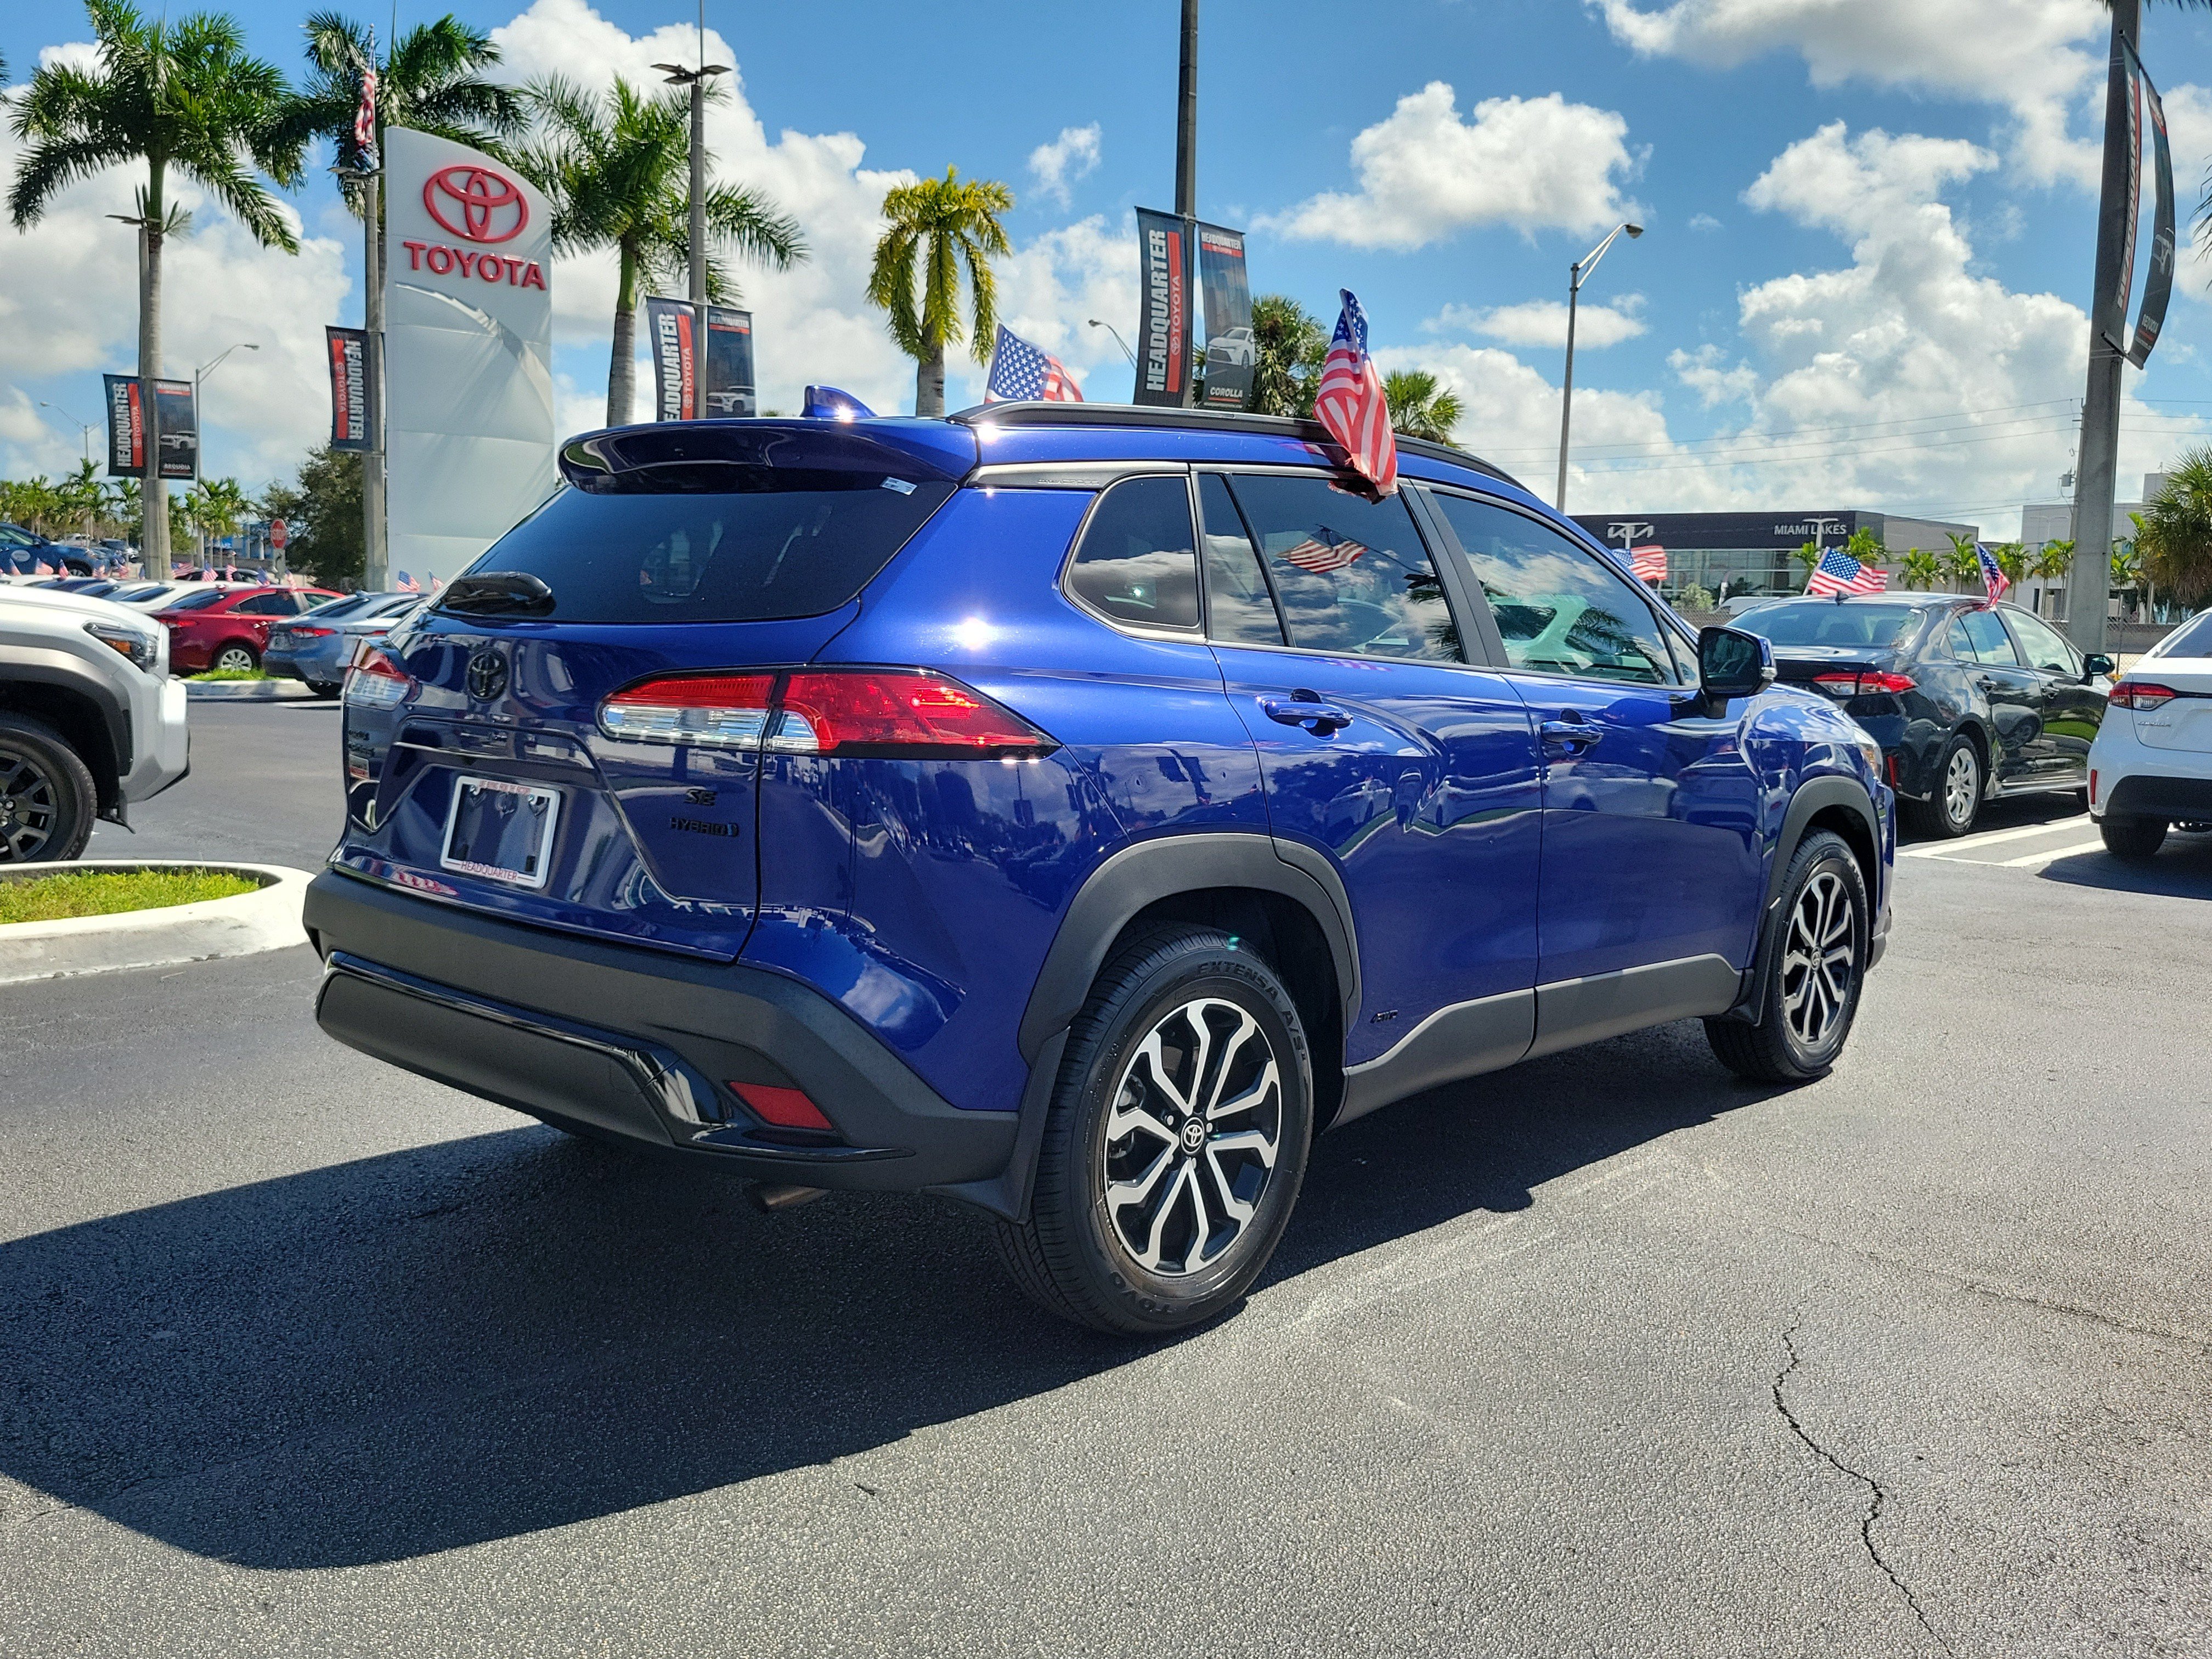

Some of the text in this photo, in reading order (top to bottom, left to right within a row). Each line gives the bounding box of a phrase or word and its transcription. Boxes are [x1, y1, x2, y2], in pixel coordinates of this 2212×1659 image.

[403, 241, 547, 290] TOYOTA
[1147, 229, 1168, 391] HEADQUARTER
[1171, 275, 1181, 334] TOYOTA
[658, 313, 684, 421] EADQUARTER
[682, 348, 693, 392] TOYOTA
[336, 375, 346, 413] TOYOTA
[344, 340, 364, 439] HEADQUARTER
[1210, 387, 1244, 398] COROLLA
[112, 383, 133, 467] HEADQUARTER
[132, 406, 141, 437] TOYOTA
[1774, 524, 1808, 535] MIAMI
[684, 789, 718, 806] SE
[670, 817, 726, 836] HYBRID
[461, 860, 518, 881] HEADQUARTER
[1198, 960, 1278, 1001] EXTENSA
[1282, 1010, 1304, 1051] A/S
